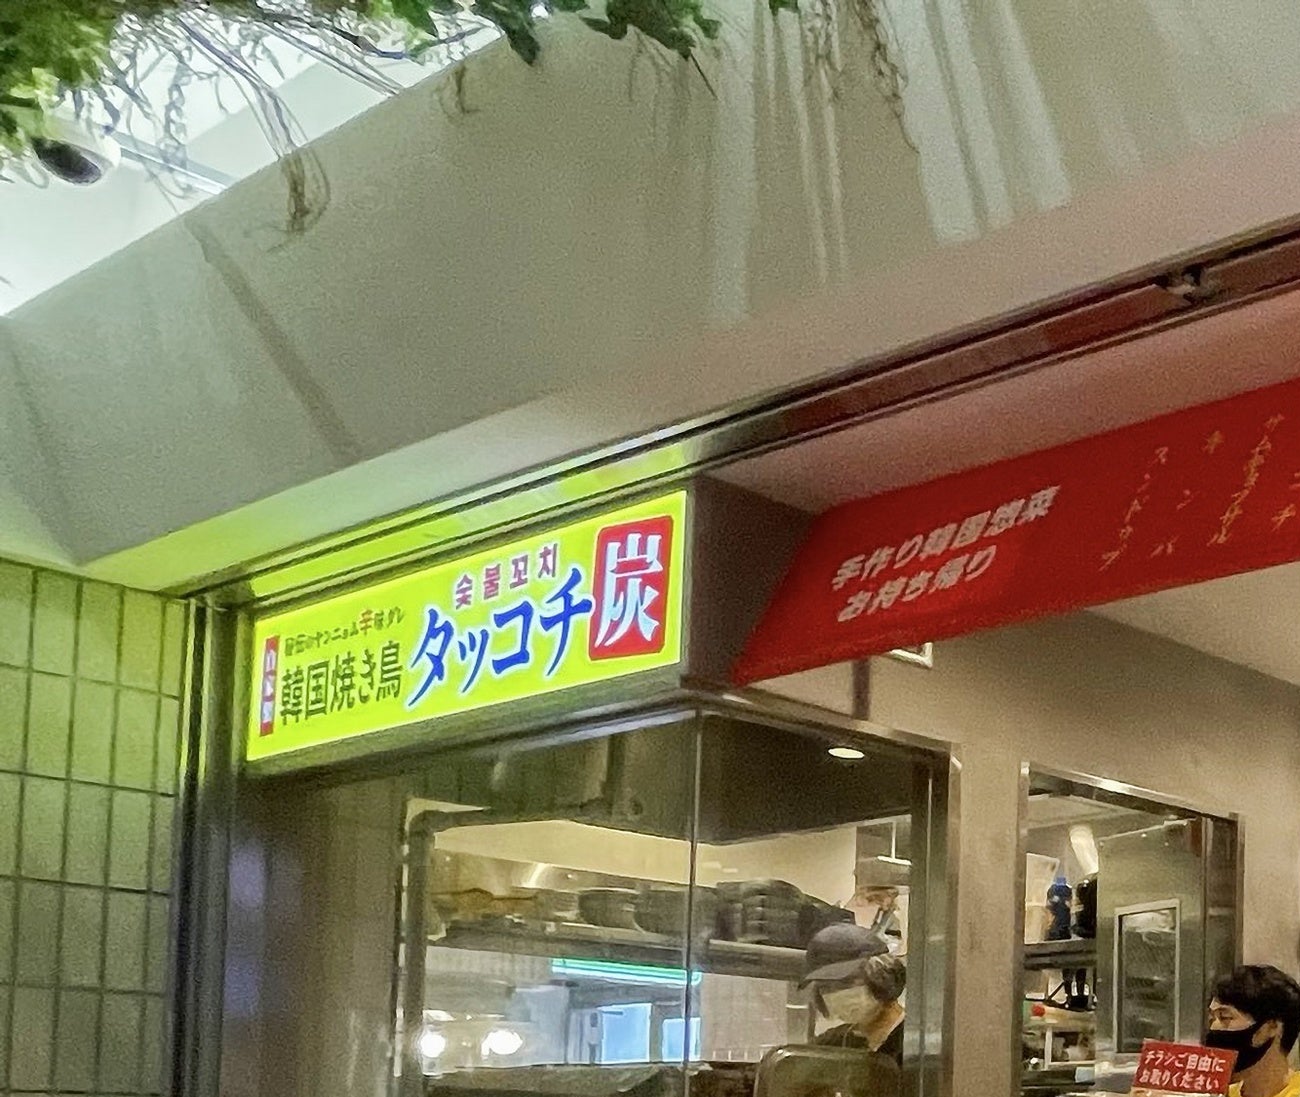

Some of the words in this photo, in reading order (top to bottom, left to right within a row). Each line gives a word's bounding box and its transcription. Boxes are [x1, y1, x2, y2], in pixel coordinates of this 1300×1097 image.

[831, 485, 1061, 591] 手作り韓国惣菜
[596, 532, 664, 649] 炭
[838, 545, 998, 623] お持ち帰り
[408, 567, 596, 708] タッコチ
[280, 641, 403, 727] 韓国焼き鳥
[1138, 1070, 1219, 1091] お取りください
[1144, 1050, 1225, 1074] チラシご自由に
